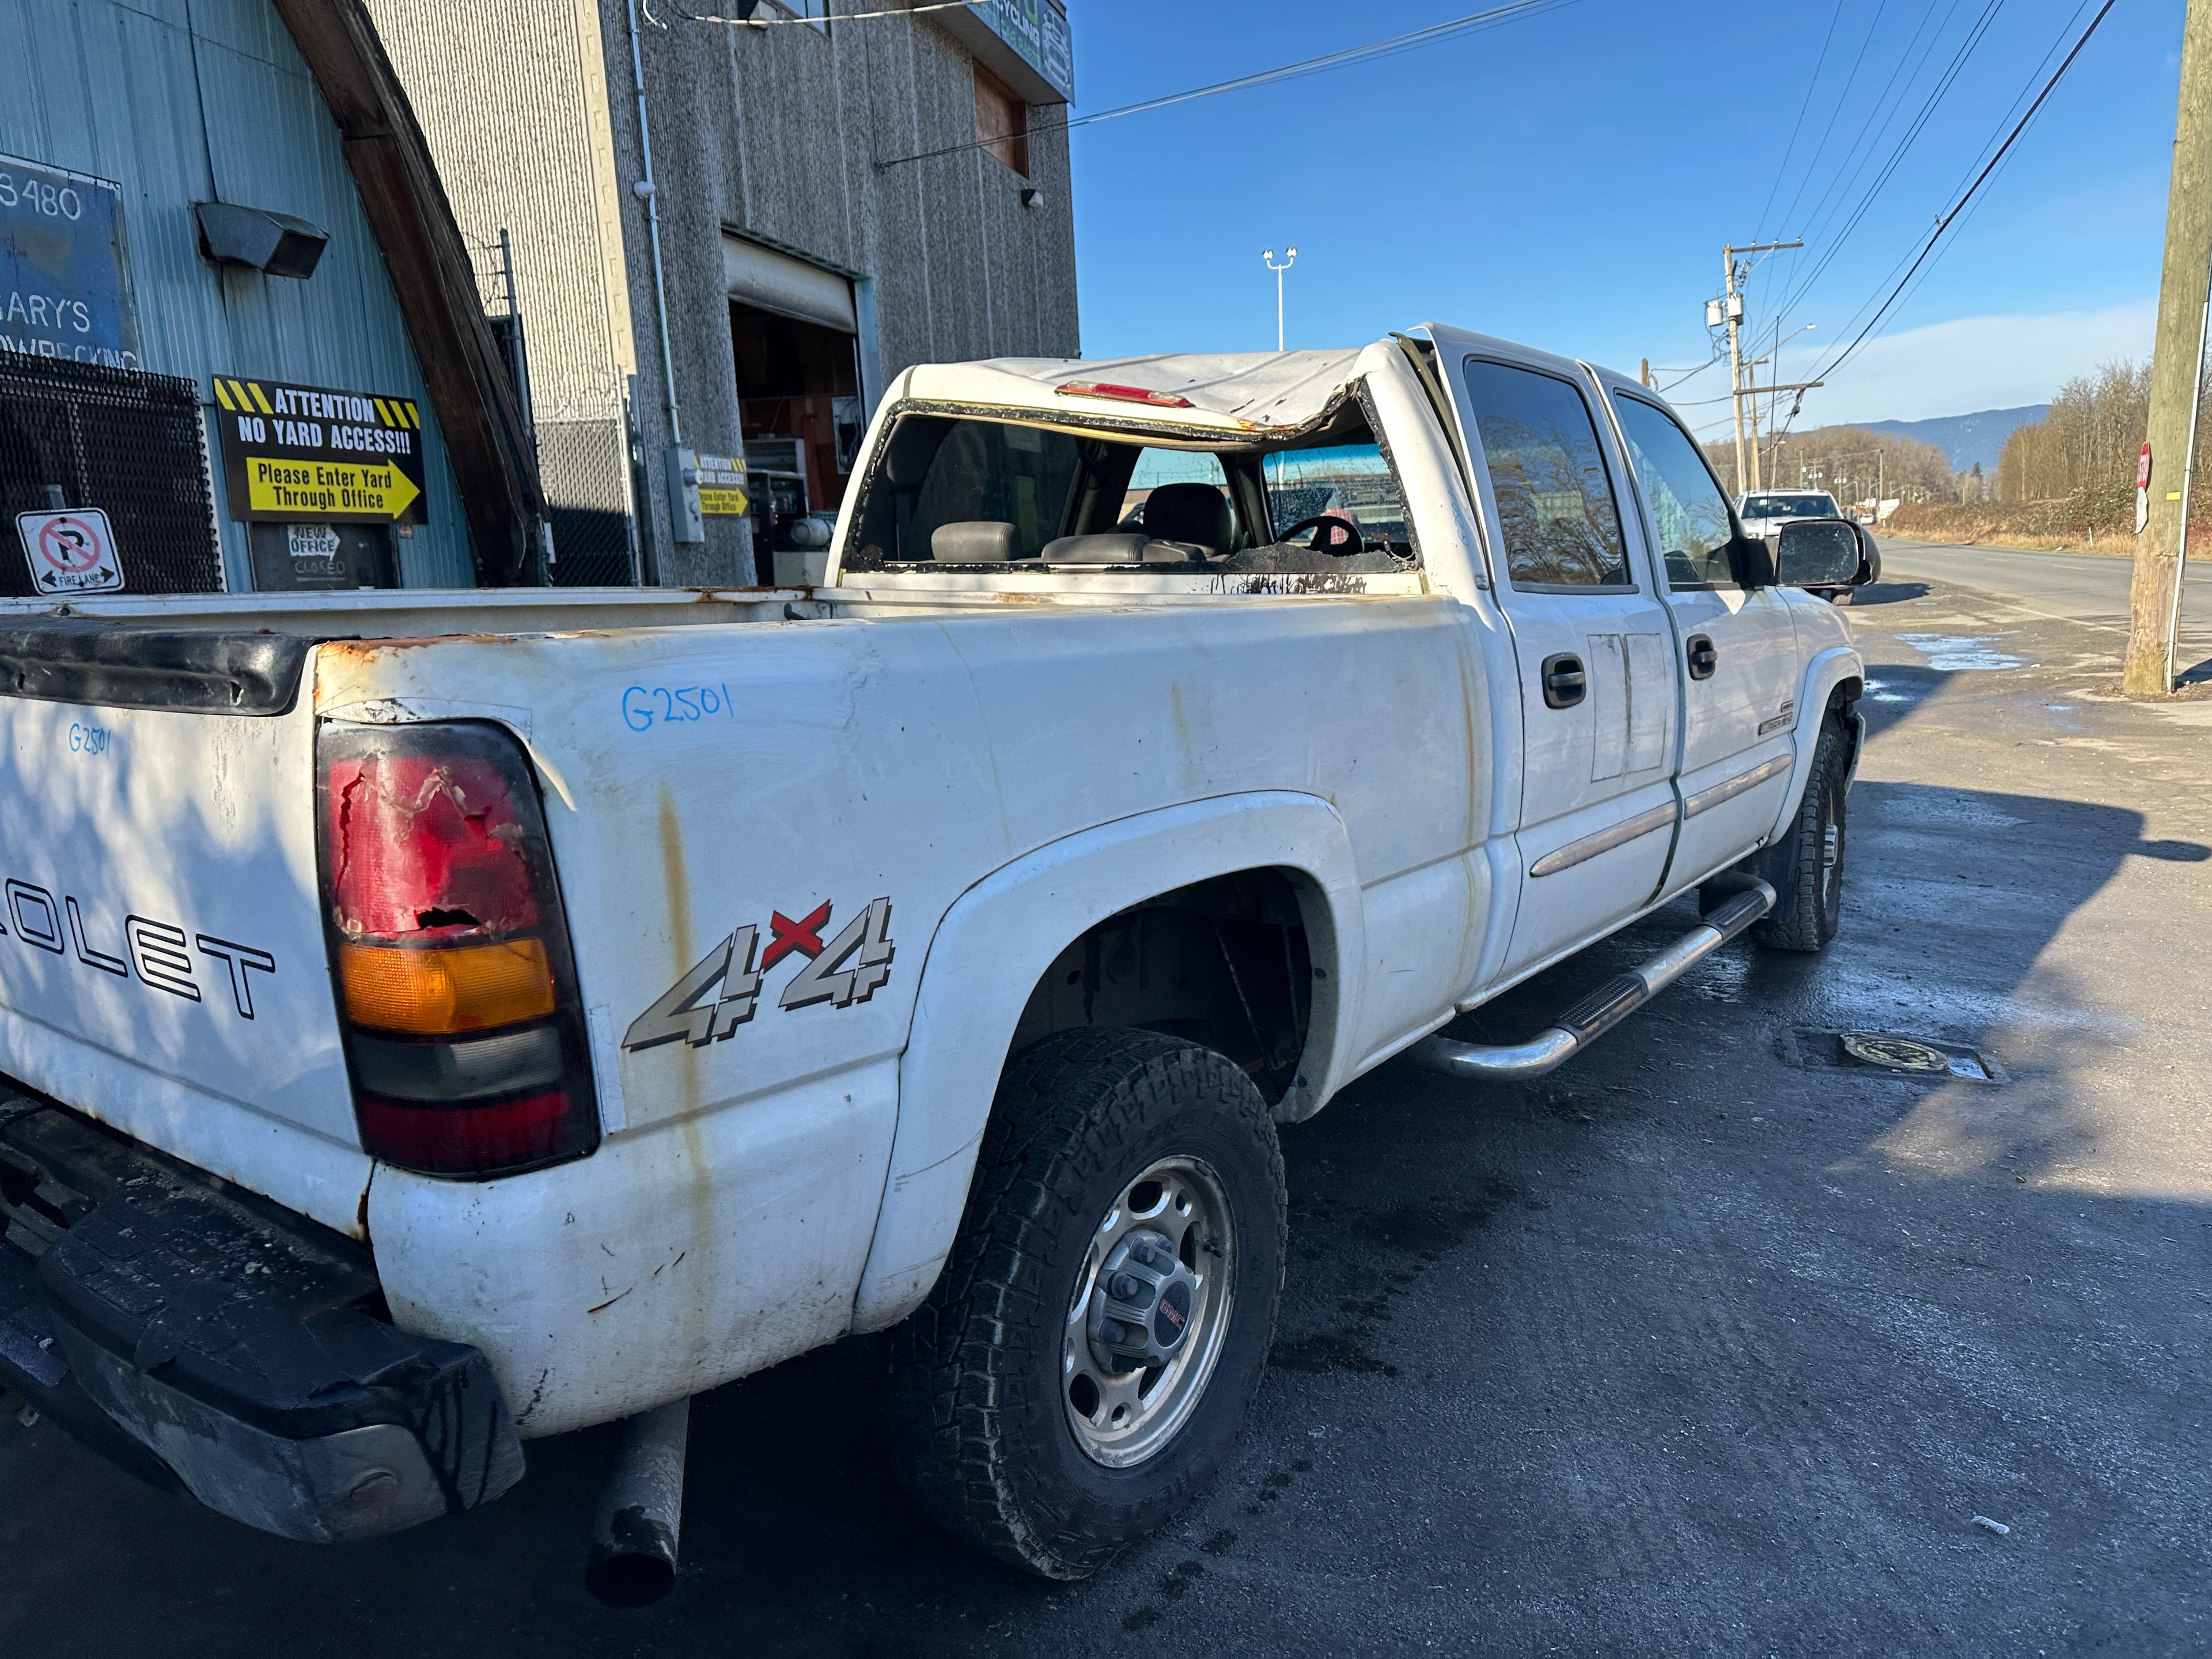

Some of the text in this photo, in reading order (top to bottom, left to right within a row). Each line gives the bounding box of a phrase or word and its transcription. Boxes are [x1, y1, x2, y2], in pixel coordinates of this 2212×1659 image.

[0, 291, 90, 332] ARY'S
[275, 388, 374, 423] ATTENTION
[238, 416, 411, 454] NO YARD ACCESS!!!
[258, 463, 392, 488] Please Enter Yard
[272, 486, 383, 510] Through Office
[290, 539, 336, 552] OFFICE
[295, 526, 327, 539] NEW
[59, 575, 78, 586] FIRE
[622, 682, 734, 732] G2501
[69, 722, 111, 760] G2501
[0, 877, 276, 1020] OLET
[1159, 1298, 1185, 1330] GMC
